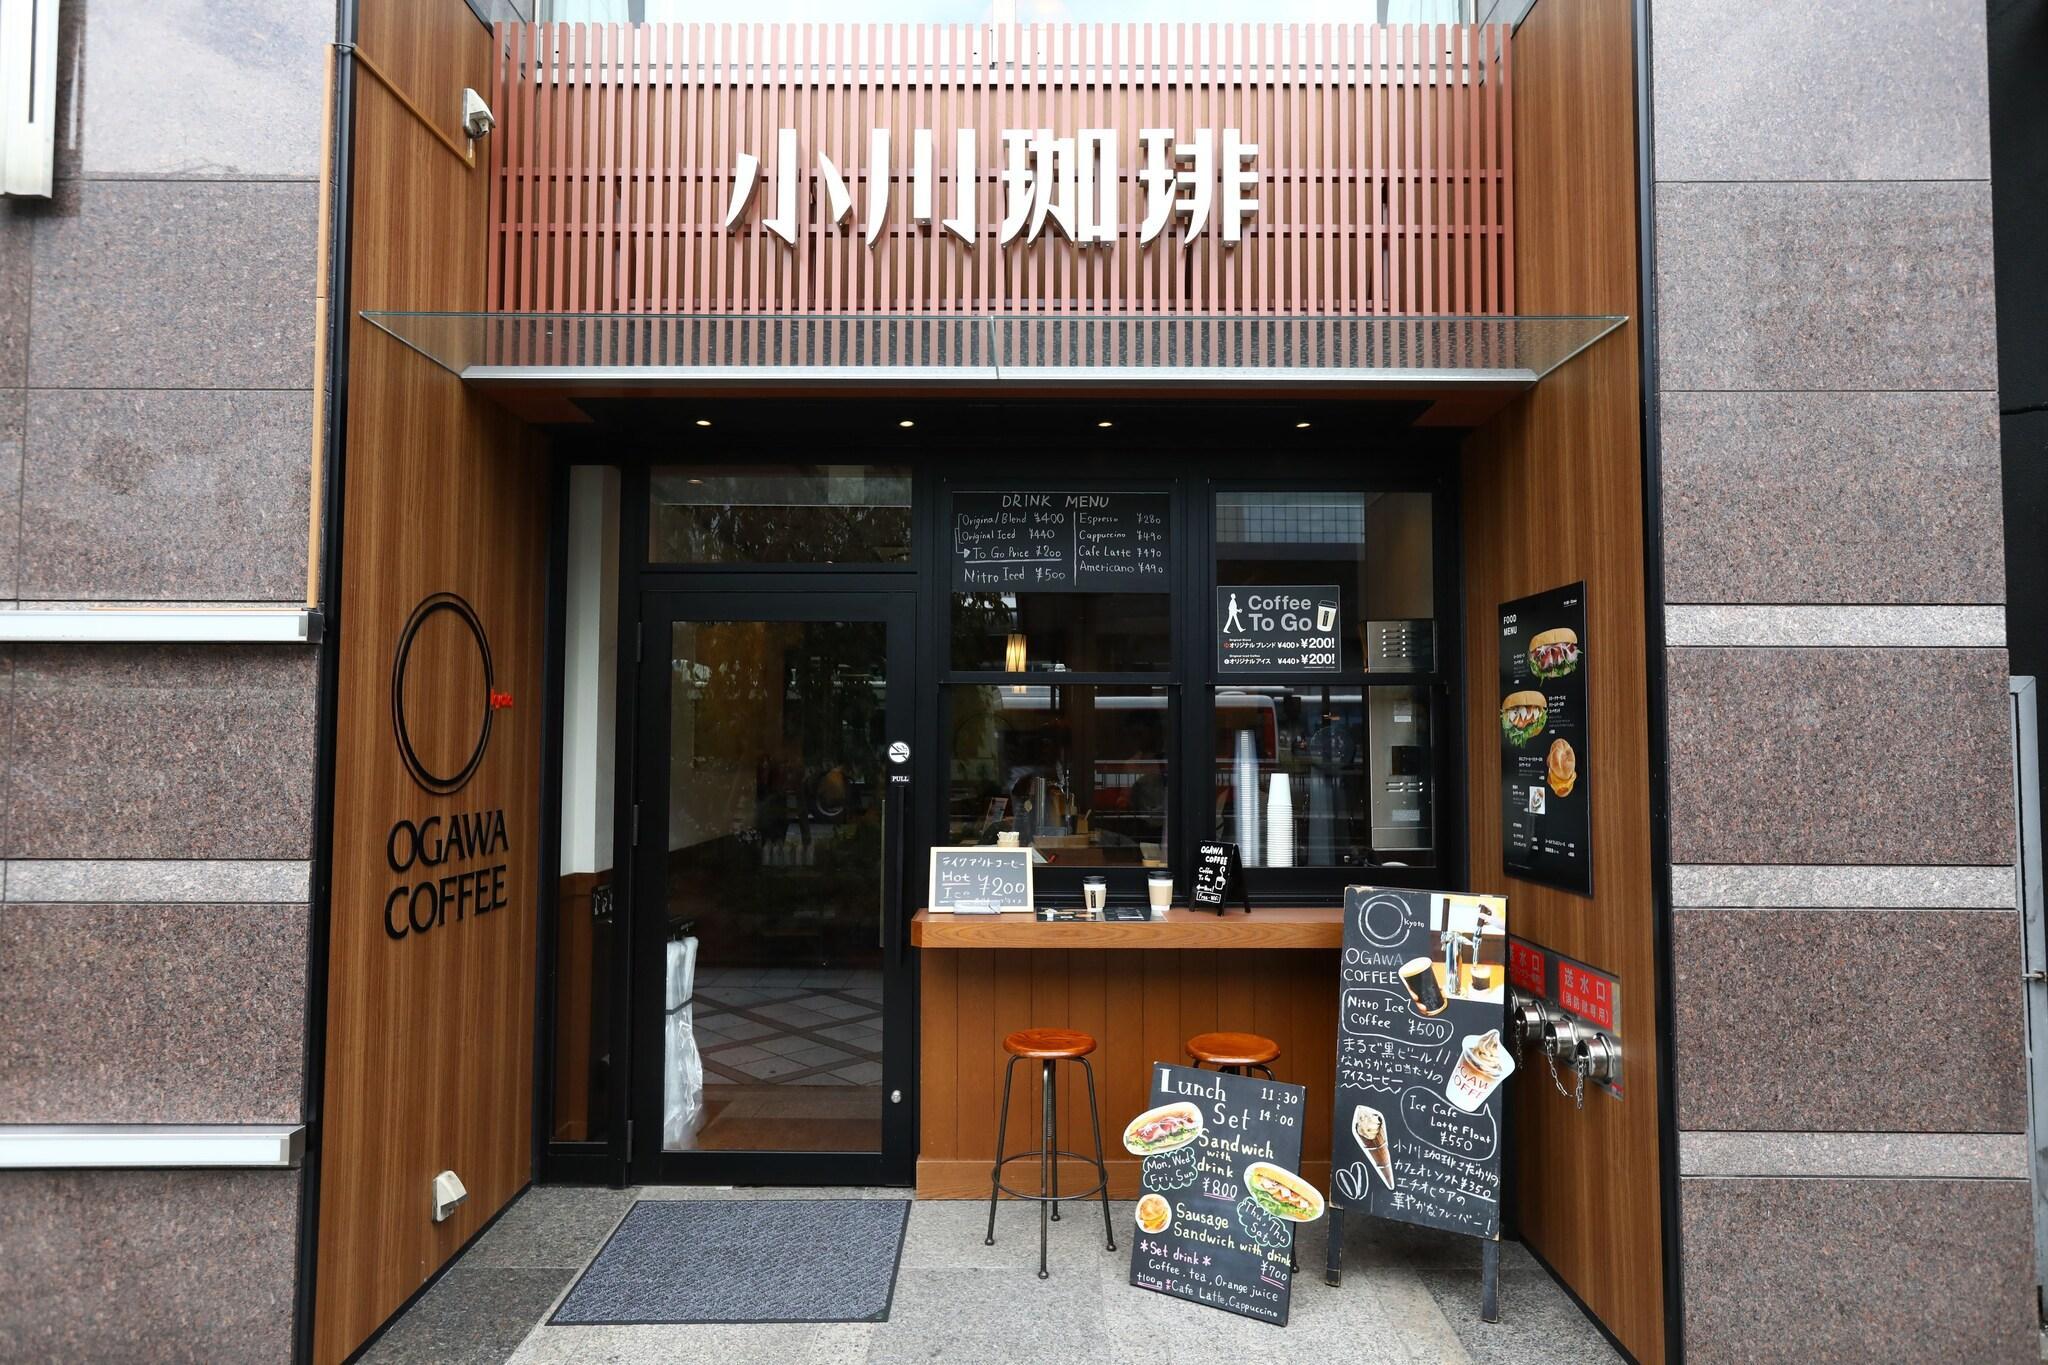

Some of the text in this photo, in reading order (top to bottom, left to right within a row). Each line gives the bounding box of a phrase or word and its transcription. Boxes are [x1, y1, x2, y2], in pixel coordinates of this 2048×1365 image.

[726, 128, 1258, 248] 小川珈琲
[1002, 494, 1109, 508] DRINK MENU
[962, 512, 1064, 530] Original Blend ¥400
[1137, 512, 1160, 524] ¥280
[962, 528, 1055, 544] Original Iced ¥440
[1079, 530, 1162, 543] Cappuccino ¥490
[972, 545, 1062, 560] To Go Price ¥200
[1078, 544, 1100, 557] Cafe
[1104, 546, 1132, 558] Latte
[964, 566, 1066, 584] Nitro Iced ¥500
[1080, 560, 1164, 574] Americano ¥490
[1248, 595, 1312, 610] Coffee
[1248, 613, 1312, 632] To Go
[1504, 614, 1517, 625] FOOD
[1504, 626, 1518, 637] MENU
[1300, 638, 1335, 649] ¥200!
[1300, 654, 1335, 665] ¥200!
[386, 809, 509, 874] OGAWA
[1200, 846, 1223, 856] OGAWA
[1205, 856, 1228, 865] COFFEE
[942, 871, 1025, 896] Hot ¥200
[384, 864, 508, 940] COFFEE
[1346, 948, 1403, 966] OGAWA
[1344, 969, 1400, 984] COFFEE
[1564, 968, 1606, 1002] 送水口
[1348, 995, 1404, 1013] Nitro Ice
[1350, 1013, 1444, 1039] Coffee ¥500
[1341, 1055, 1443, 1084] なめらかな口当たりの
[1342, 1070, 1403, 1085] アイスコーヒー
[1160, 1068, 1226, 1102] Lunch
[1261, 1088, 1298, 1104] 11:30
[1410, 1095, 1457, 1118] Ice Cafe
[1212, 1103, 1250, 1130] Set
[1260, 1109, 1294, 1126] 14:00
[1431, 1116, 1492, 1143] Latte Float
[1198, 1128, 1274, 1160] Sandwich
[1440, 1132, 1472, 1150] ¥550
[1172, 1152, 1190, 1166] Wed
[1206, 1150, 1232, 1162] with
[1176, 1169, 1194, 1181] Sun
[1197, 1156, 1234, 1178] drink
[1203, 1177, 1238, 1198] ¥800
[1397, 1177, 1466, 1206] エチオピアの
[1460, 1176, 1491, 1199] ¥350
[1176, 1203, 1229, 1230] Sausage
[1250, 1222, 1269, 1242] Sat
[1270, 1220, 1286, 1243] Thu
[1174, 1222, 1291, 1267] Sandwich with drink
[1260, 1260, 1288, 1281] ¥700
[1215, 1274, 1248, 1294] Orange
[1250, 1286, 1278, 1301] juice
[1172, 1280, 1193, 1295] Cafe
[1229, 1296, 1278, 1317] Cappuccino
